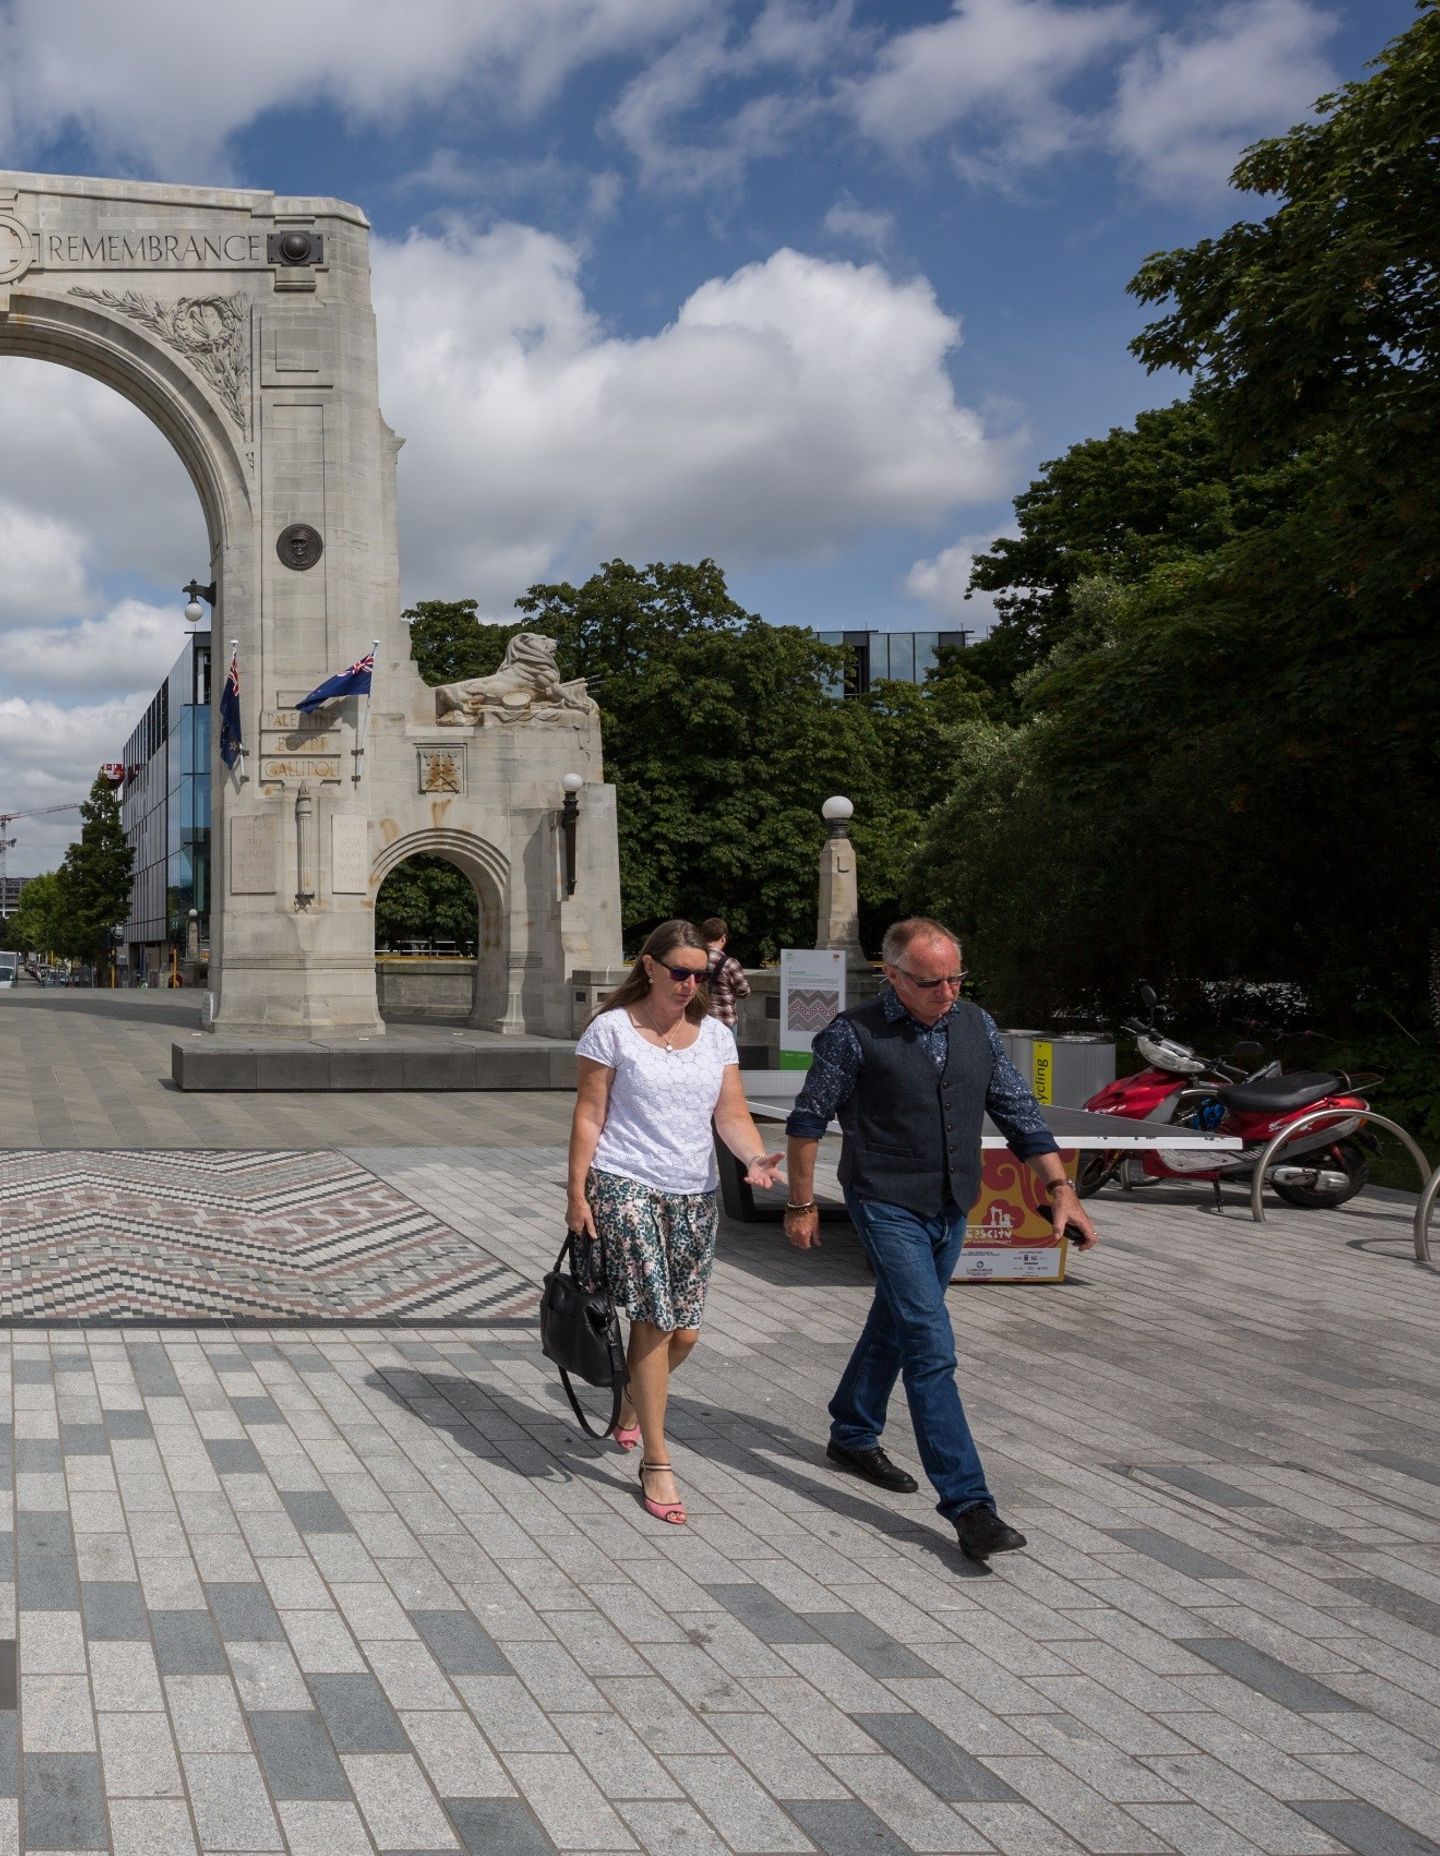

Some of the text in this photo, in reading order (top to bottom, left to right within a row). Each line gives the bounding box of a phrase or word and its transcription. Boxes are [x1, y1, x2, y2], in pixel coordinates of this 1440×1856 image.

[48, 234, 261, 262] REMEMBRANCE
[277, 736, 327, 752] EGYPT
[264, 760, 340, 778] GALLIPOLI
[1035, 1057, 1050, 1105] ycling
